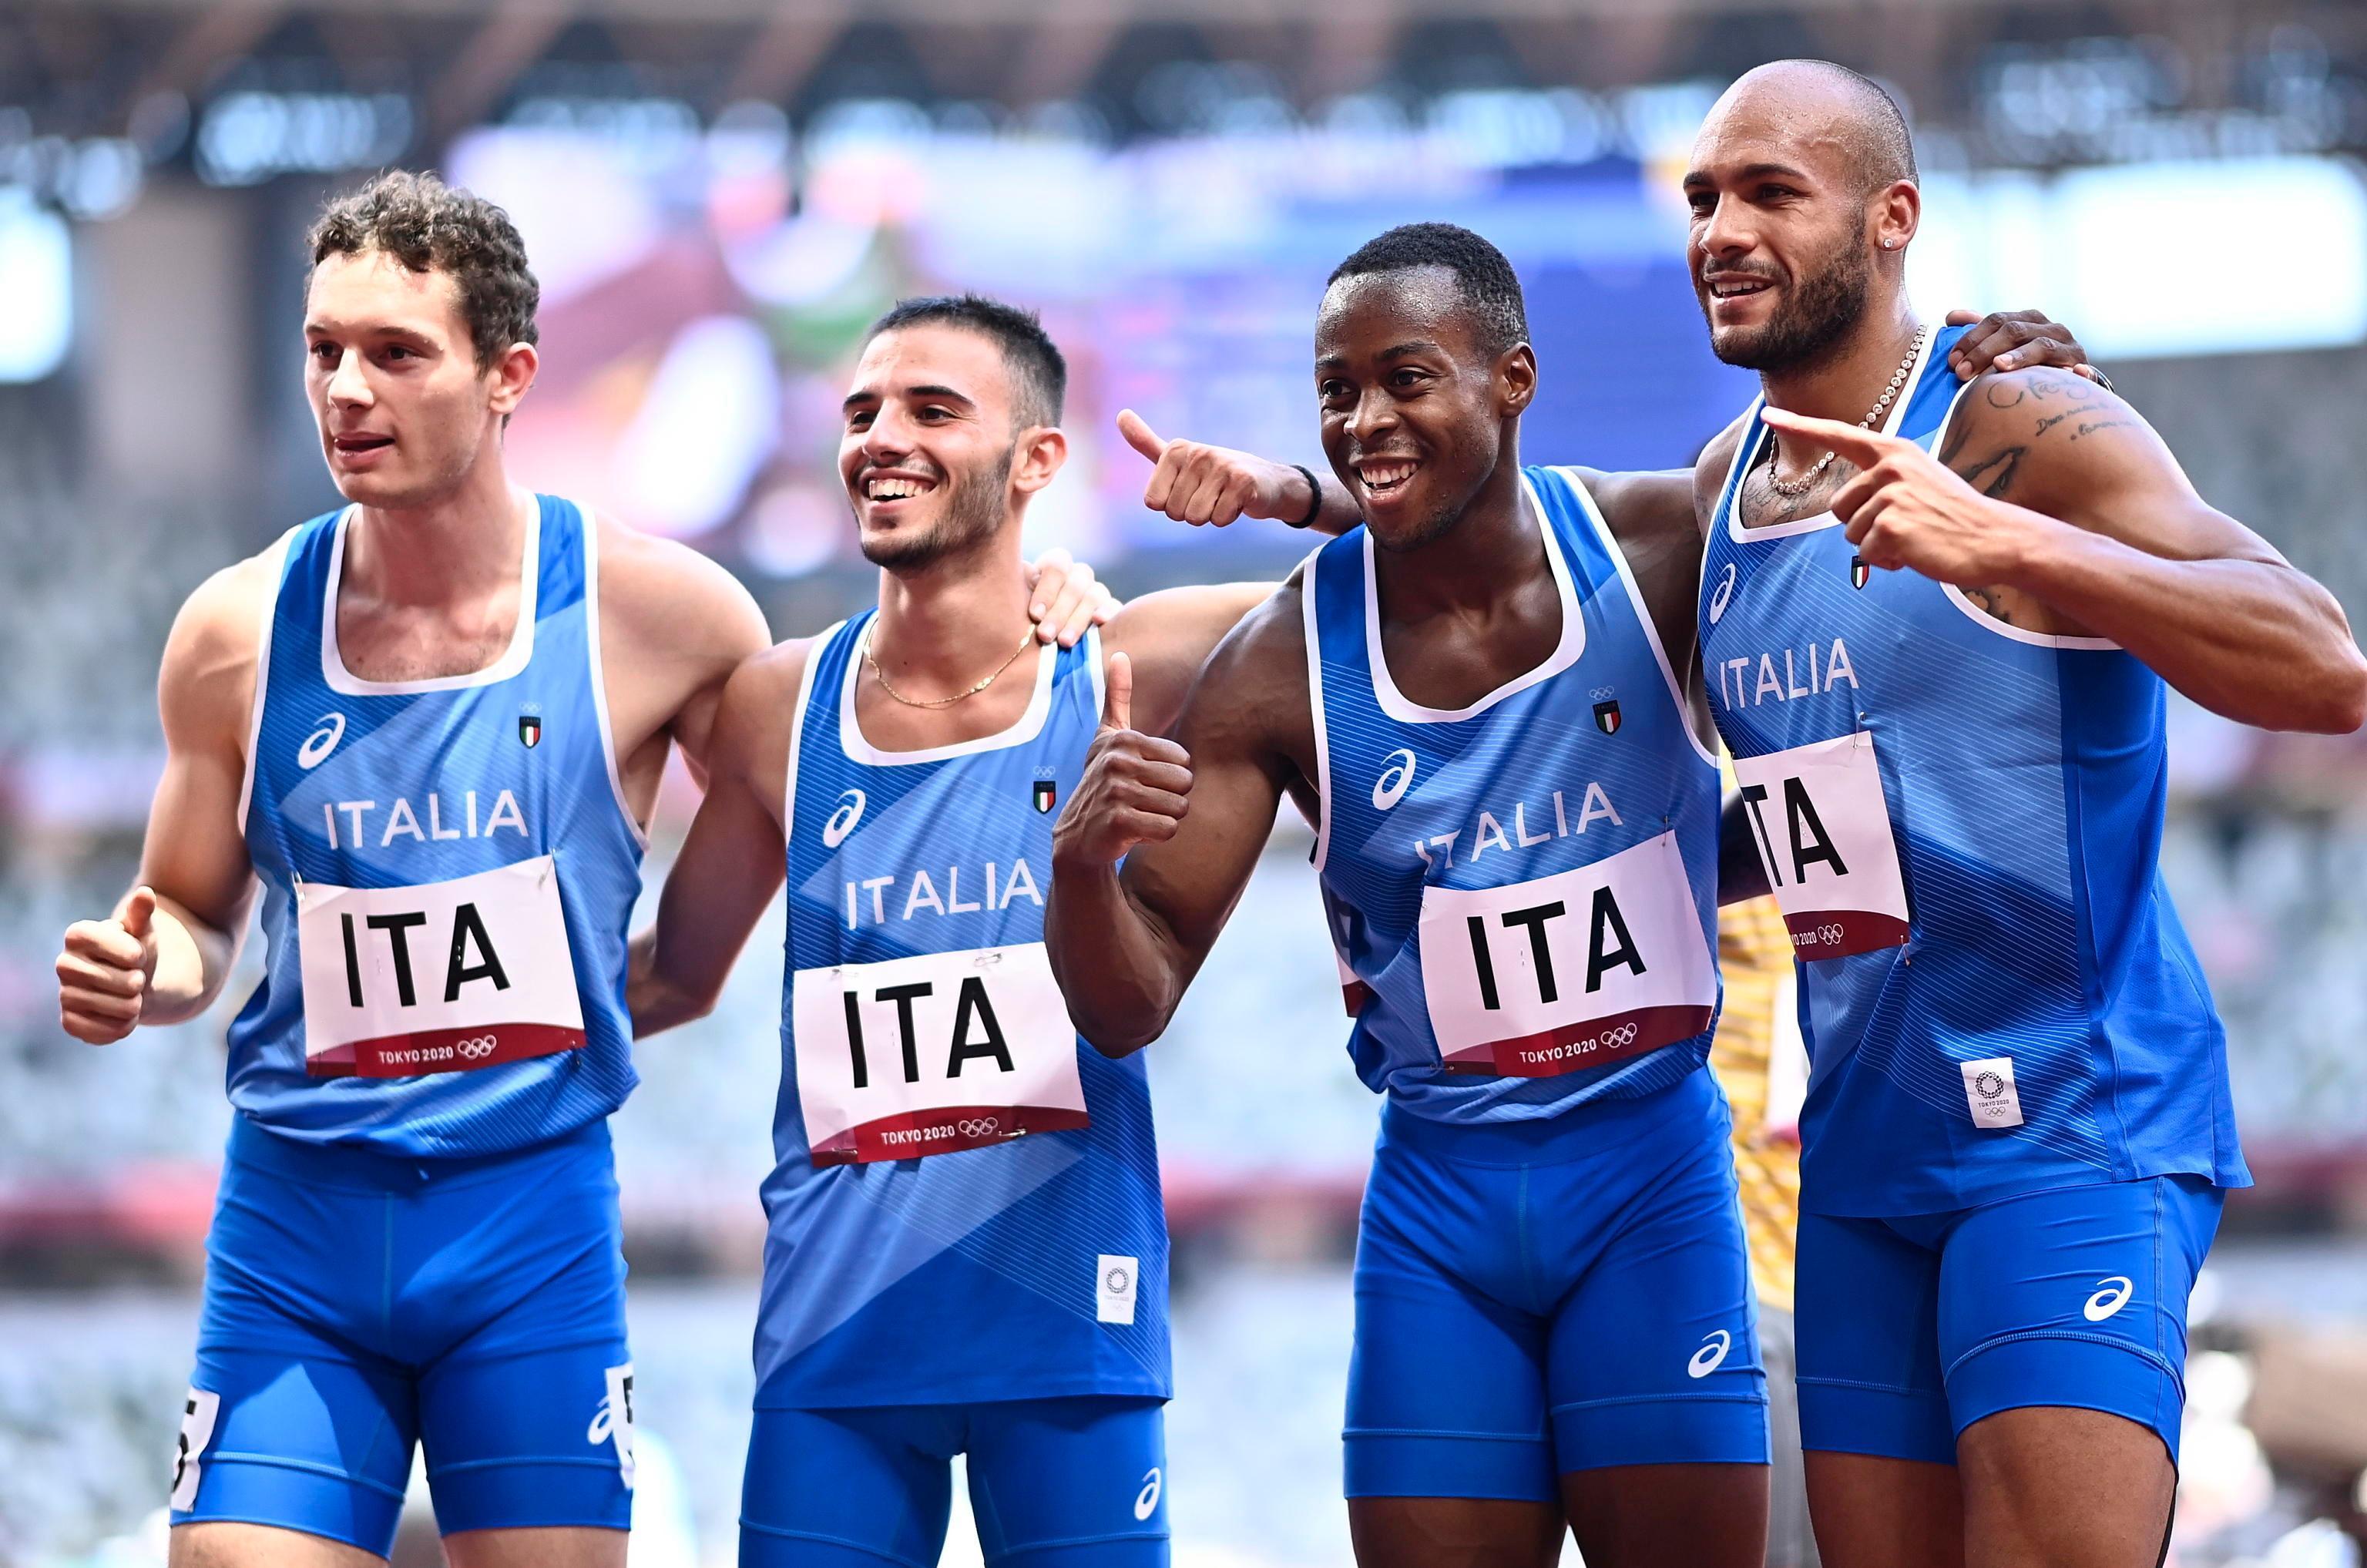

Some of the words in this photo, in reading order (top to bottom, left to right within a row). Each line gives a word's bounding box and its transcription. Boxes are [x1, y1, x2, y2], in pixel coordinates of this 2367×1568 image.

[1719, 637, 1860, 711] ITALIA
[324, 789, 529, 849] ITALIA
[1414, 781, 1623, 876] ITALIA
[1741, 776, 1850, 888] TA
[846, 858, 1044, 930] ITALIA
[341, 902, 511, 1008] ITA
[1466, 885, 1647, 1010] ITA
[1799, 931, 1818, 945] 2020
[378, 1049, 420, 1064] TOKYO
[421, 1046, 454, 1062] 2020
[843, 975, 1016, 1089] ITA
[1519, 1047, 1563, 1063] TOKYO
[1564, 1039, 1597, 1057] 2020
[881, 1129, 922, 1145] TOKYO
[923, 1125, 955, 1141] 2020
